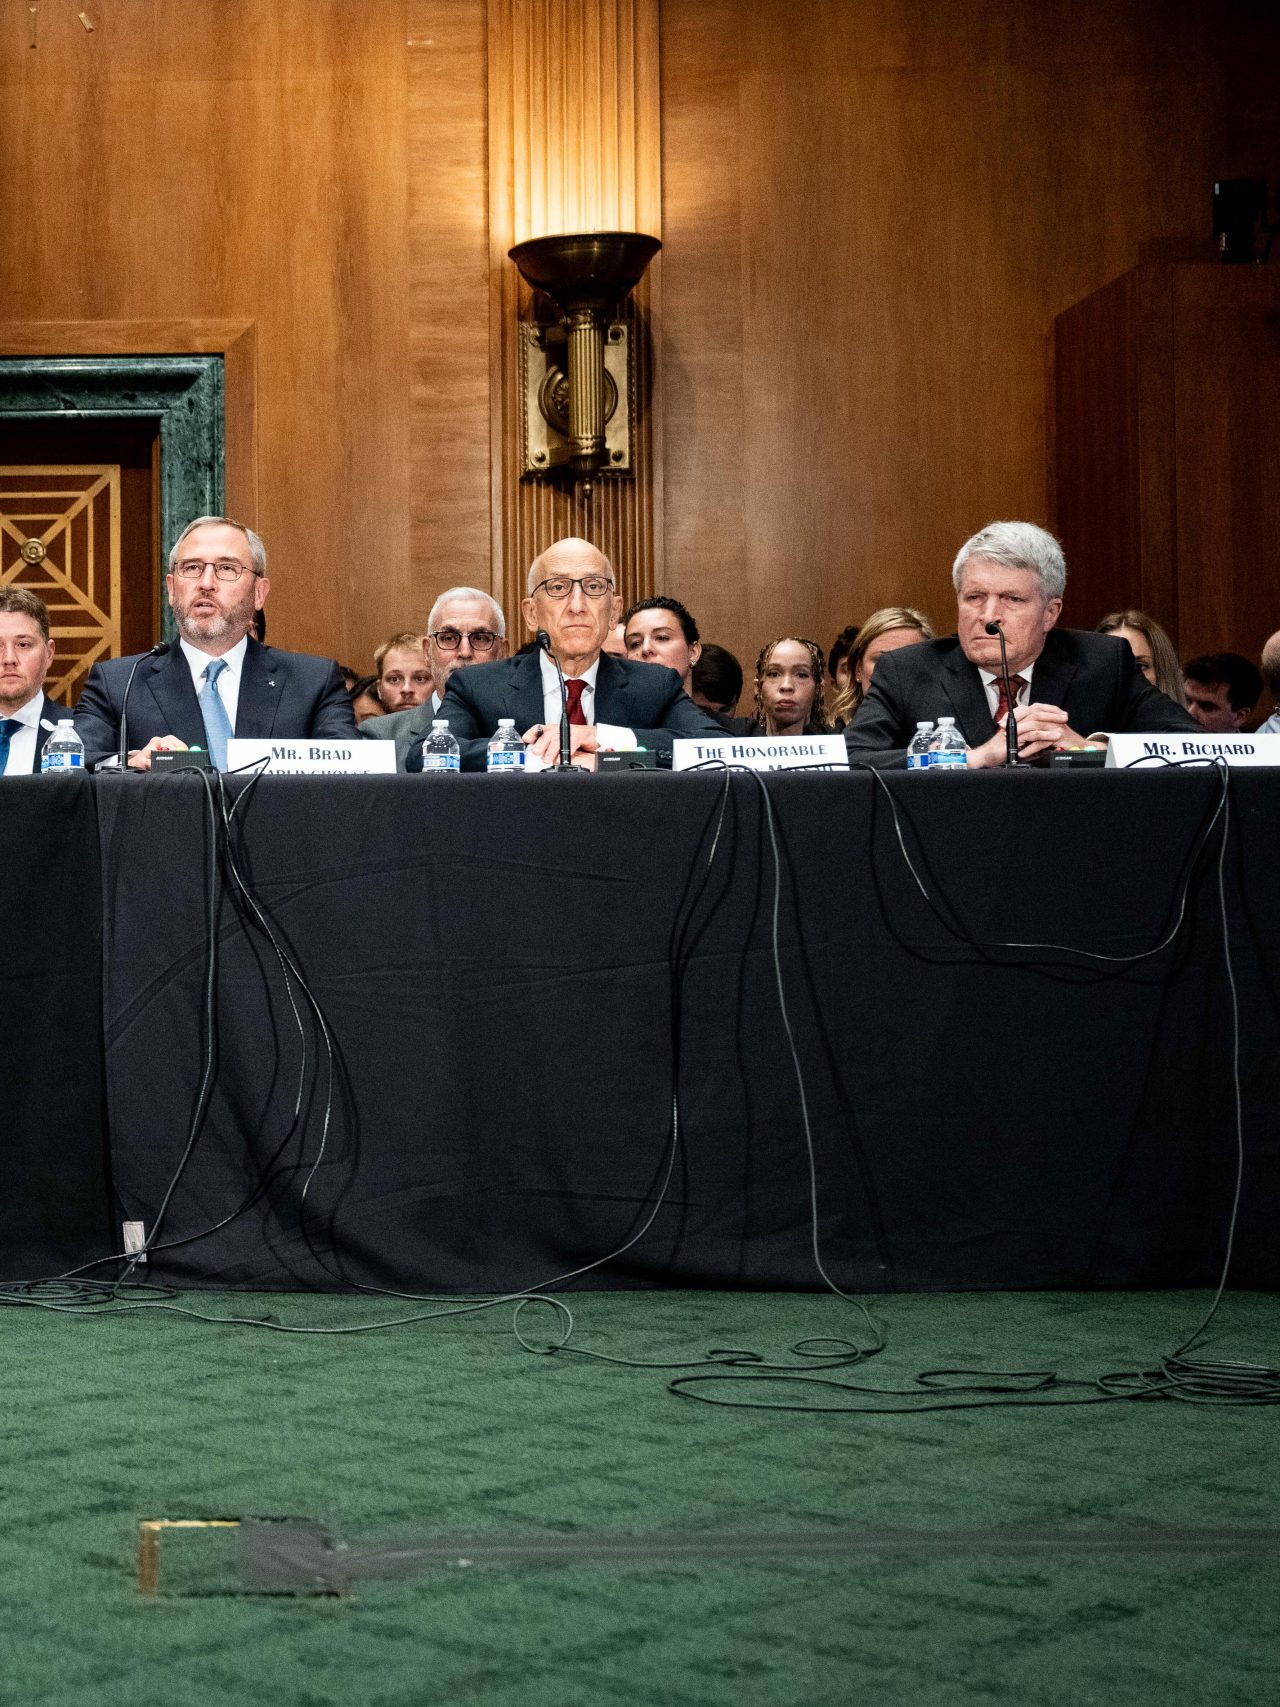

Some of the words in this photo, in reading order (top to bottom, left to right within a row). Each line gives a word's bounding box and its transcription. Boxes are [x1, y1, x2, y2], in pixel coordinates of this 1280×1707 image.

[271, 746, 302, 760] MR.
[309, 747, 352, 760] BRAD
[694, 746, 726, 759] THE
[731, 744, 828, 759] HONORABLE
[1143, 742, 1176, 755] MR.
[1182, 742, 1255, 755] RICHARD
